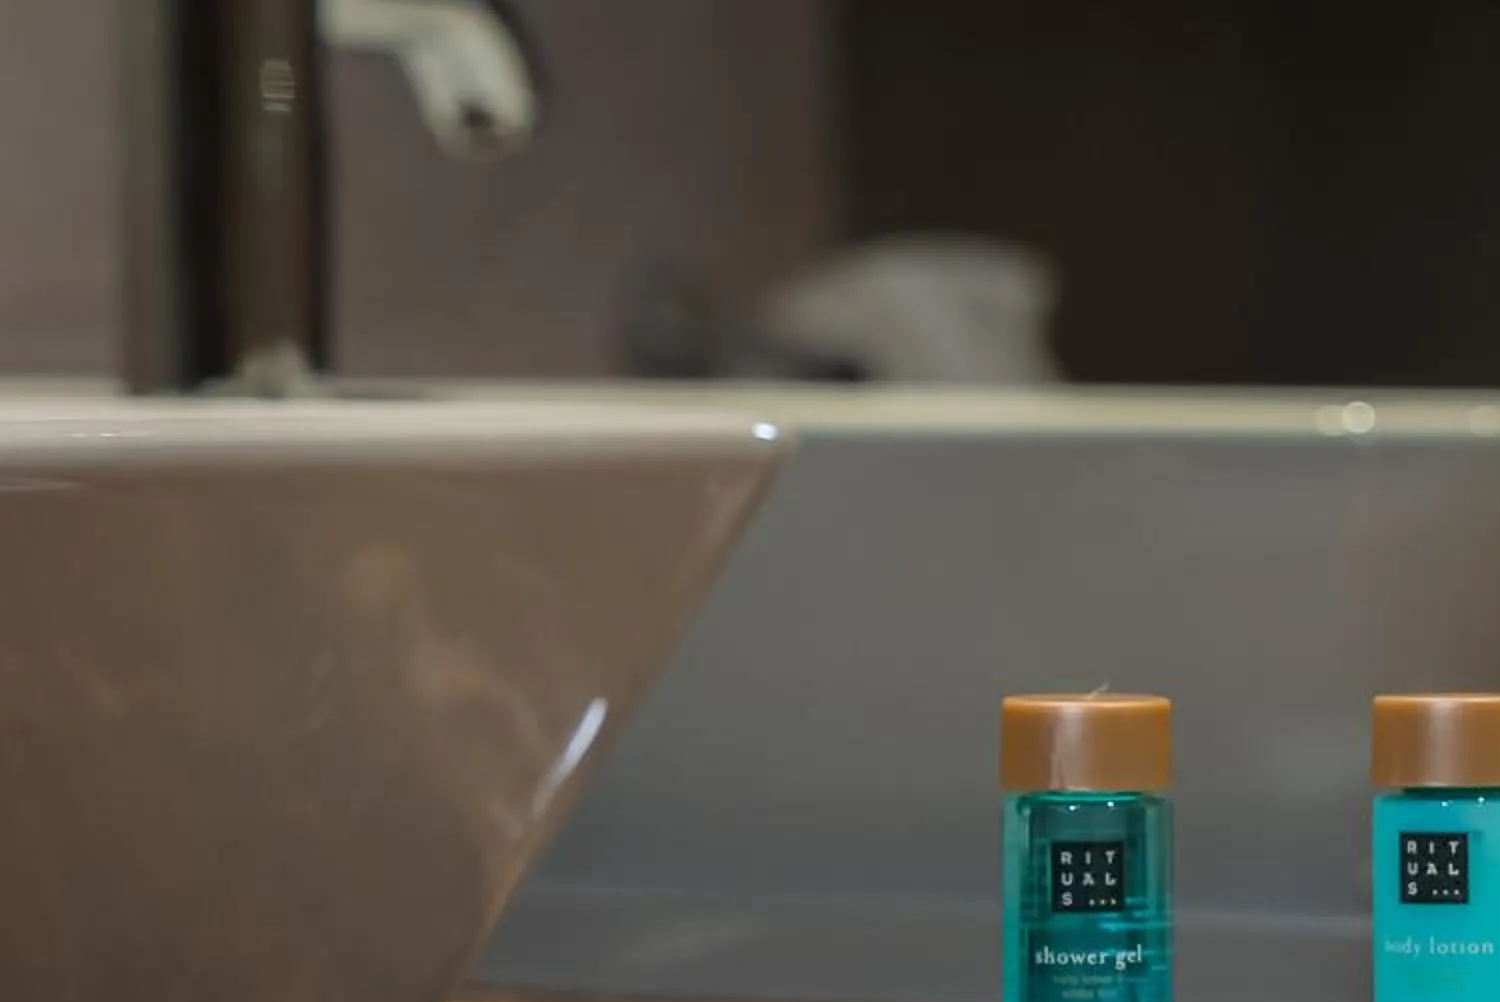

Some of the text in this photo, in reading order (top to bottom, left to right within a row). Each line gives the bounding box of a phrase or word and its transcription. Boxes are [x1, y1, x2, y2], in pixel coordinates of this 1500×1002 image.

[1429, 935, 1495, 955] lotion
[1035, 944, 1142, 971] shower gel
